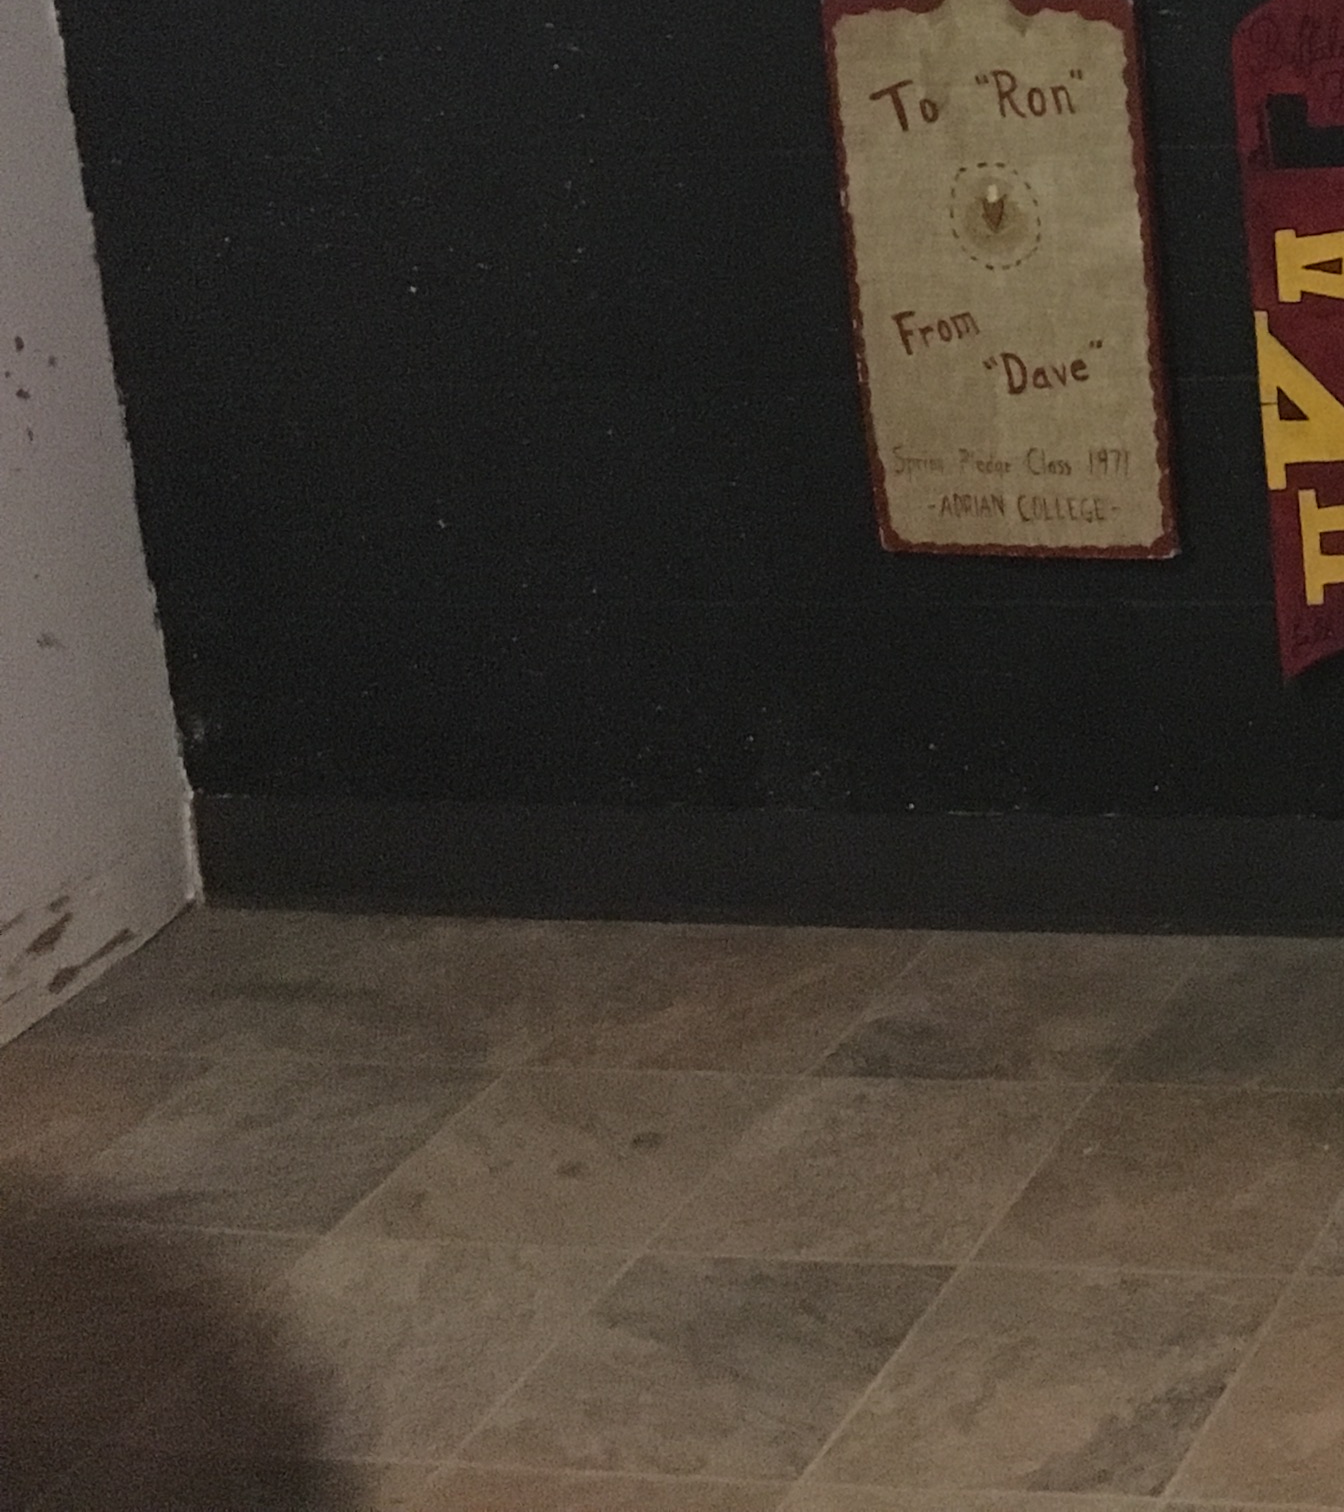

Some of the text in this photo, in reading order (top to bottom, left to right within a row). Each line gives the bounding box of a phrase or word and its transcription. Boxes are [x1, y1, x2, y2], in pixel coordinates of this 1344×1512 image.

[870, 68, 1084, 132] To "Ron"
[891, 309, 981, 356] From
[982, 339, 1105, 396] "Dave"
[1026, 446, 1072, 476] Class
